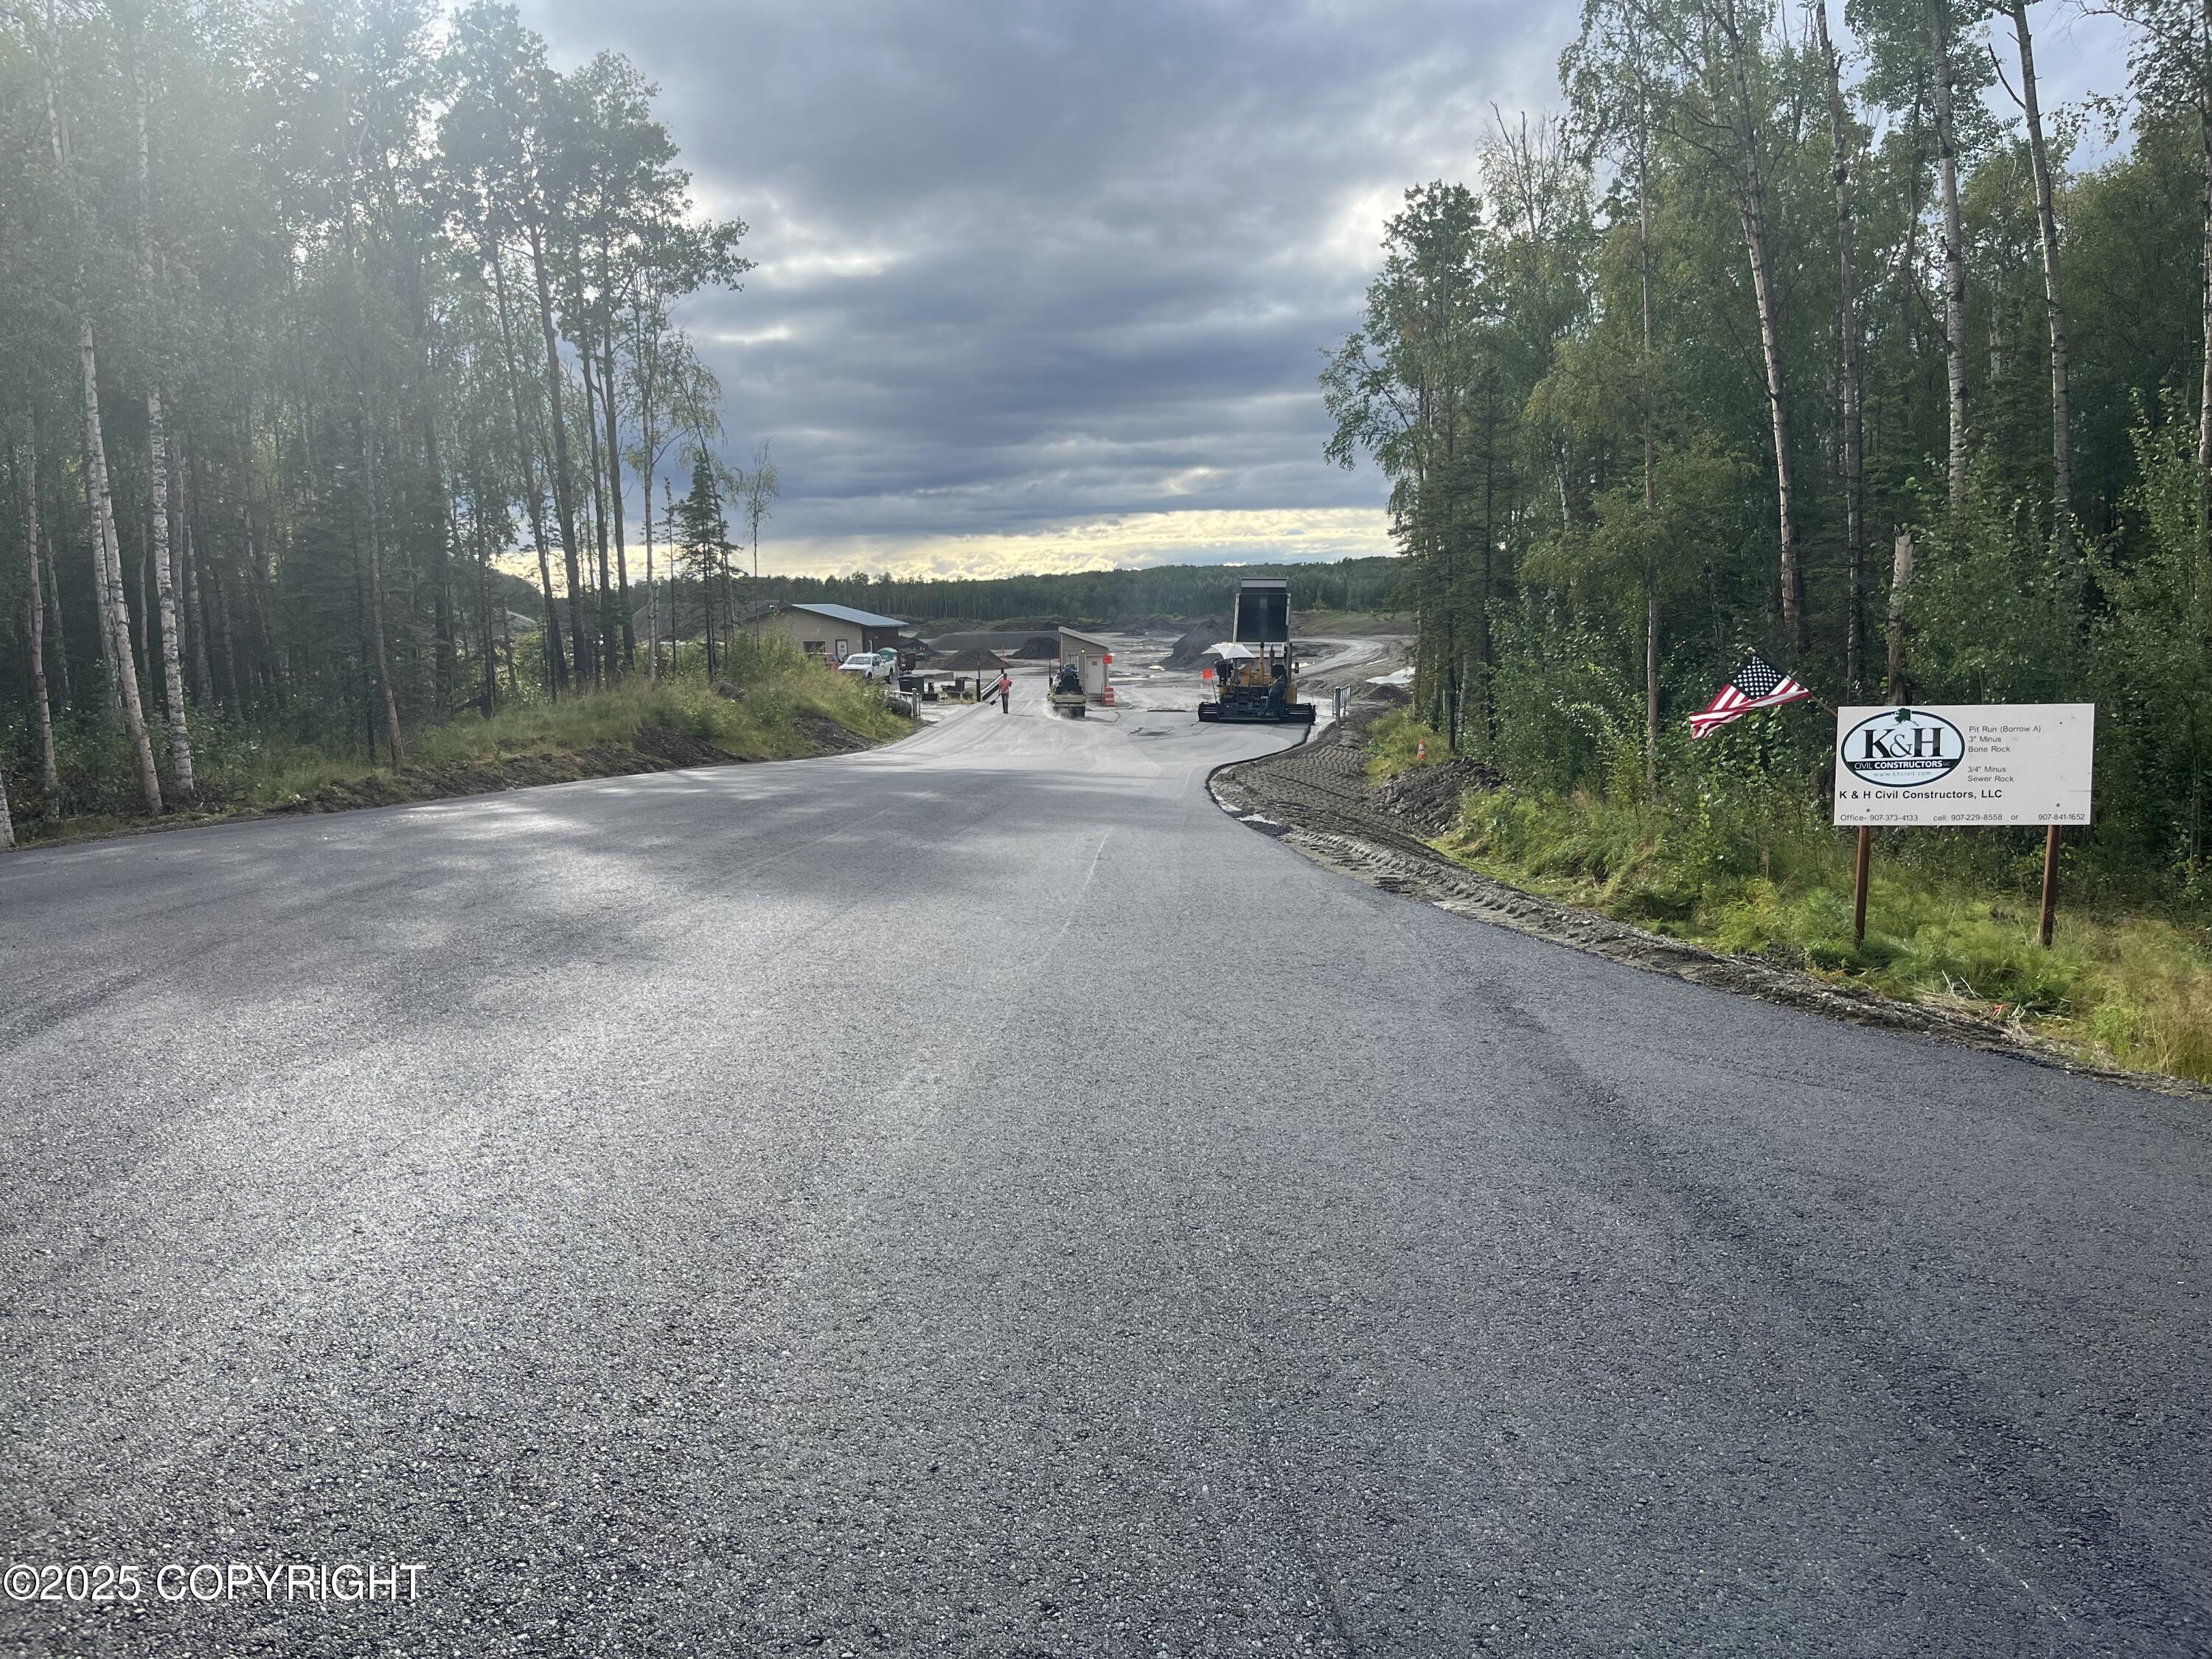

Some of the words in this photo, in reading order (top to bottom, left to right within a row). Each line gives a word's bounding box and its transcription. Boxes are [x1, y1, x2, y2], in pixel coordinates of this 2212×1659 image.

[2000, 726, 2030, 734] (Borrow
[2033, 726, 2041, 734] A)
[1861, 727, 1945, 759] K&H
[1854, 762, 1873, 770] CIVIL
[1874, 760, 1943, 769] CONSTRUCTORS
[1839, 790, 1847, 799] K
[1851, 790, 1859, 799] &
[1863, 790, 1871, 799] H
[1875, 790, 1898, 799] Civil
[1902, 790, 1977, 800] Constructors,
[1981, 790, 2002, 798] LLC
